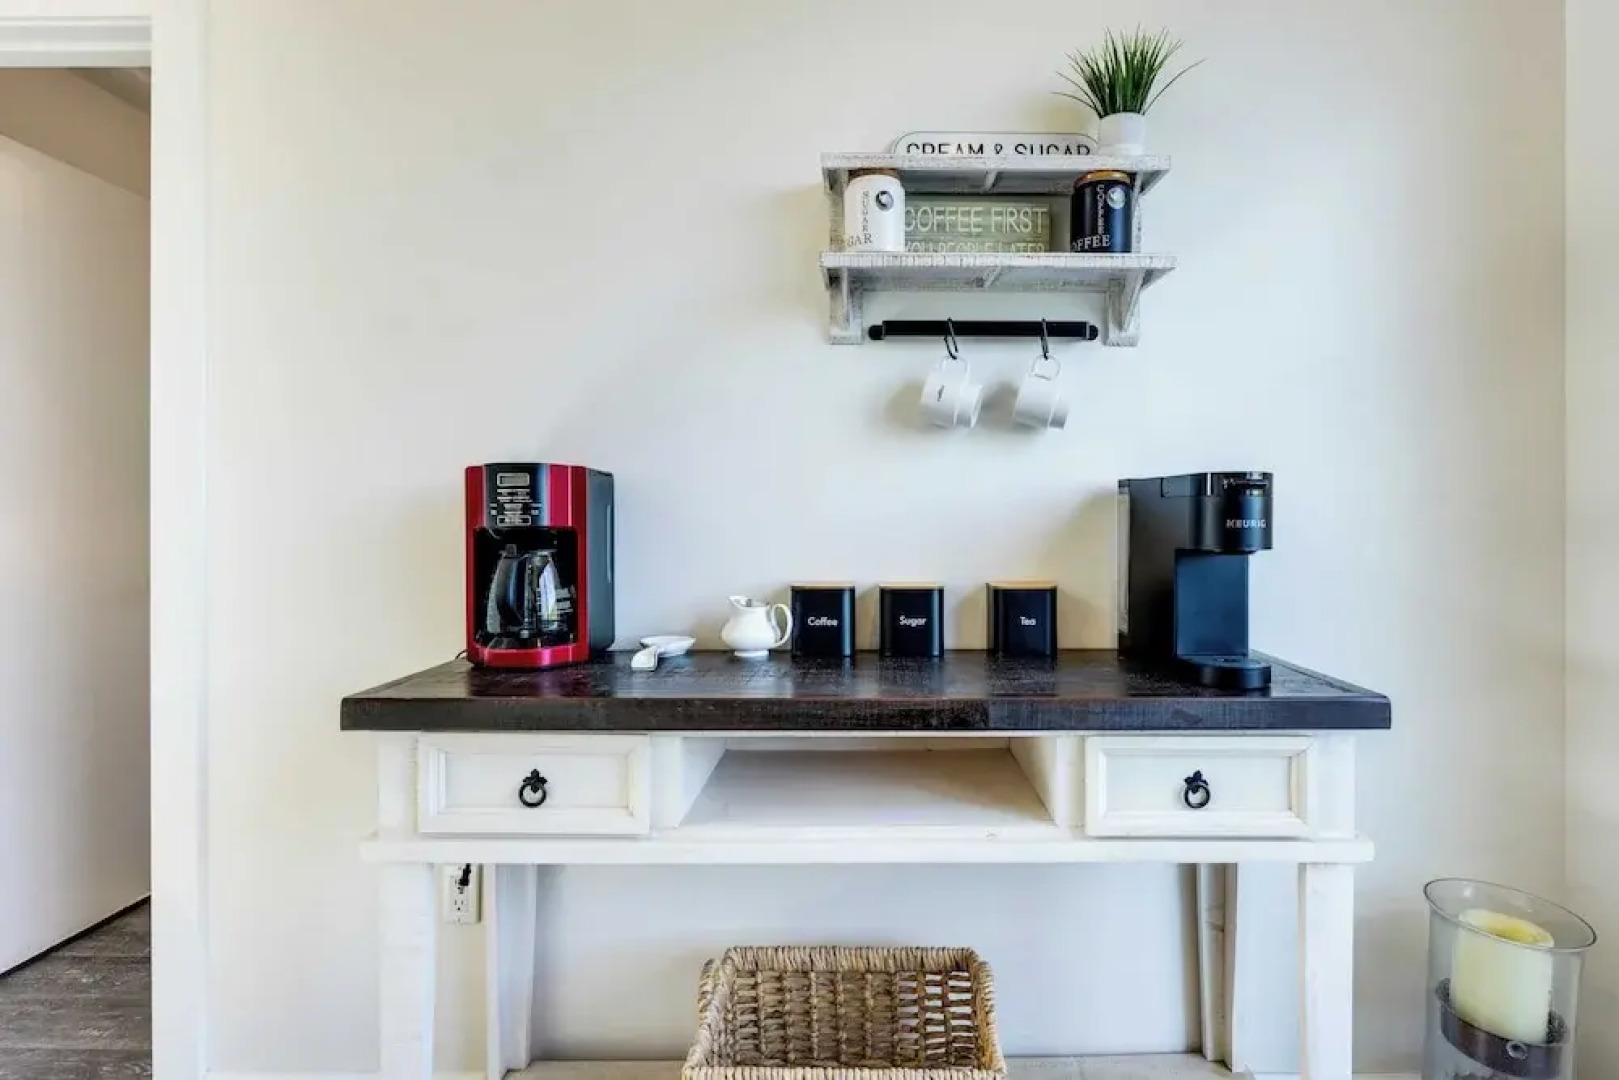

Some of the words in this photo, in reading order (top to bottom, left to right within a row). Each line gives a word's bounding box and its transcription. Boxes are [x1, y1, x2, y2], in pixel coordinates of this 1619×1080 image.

[905, 206, 984, 233] COFFEE
[992, 206, 1048, 234] FIRST
[1226, 519, 1267, 529] KEURIG
[807, 616, 838, 626] Coffee
[899, 614, 928, 627] Sugar
[1020, 616, 1036, 626] Tea
